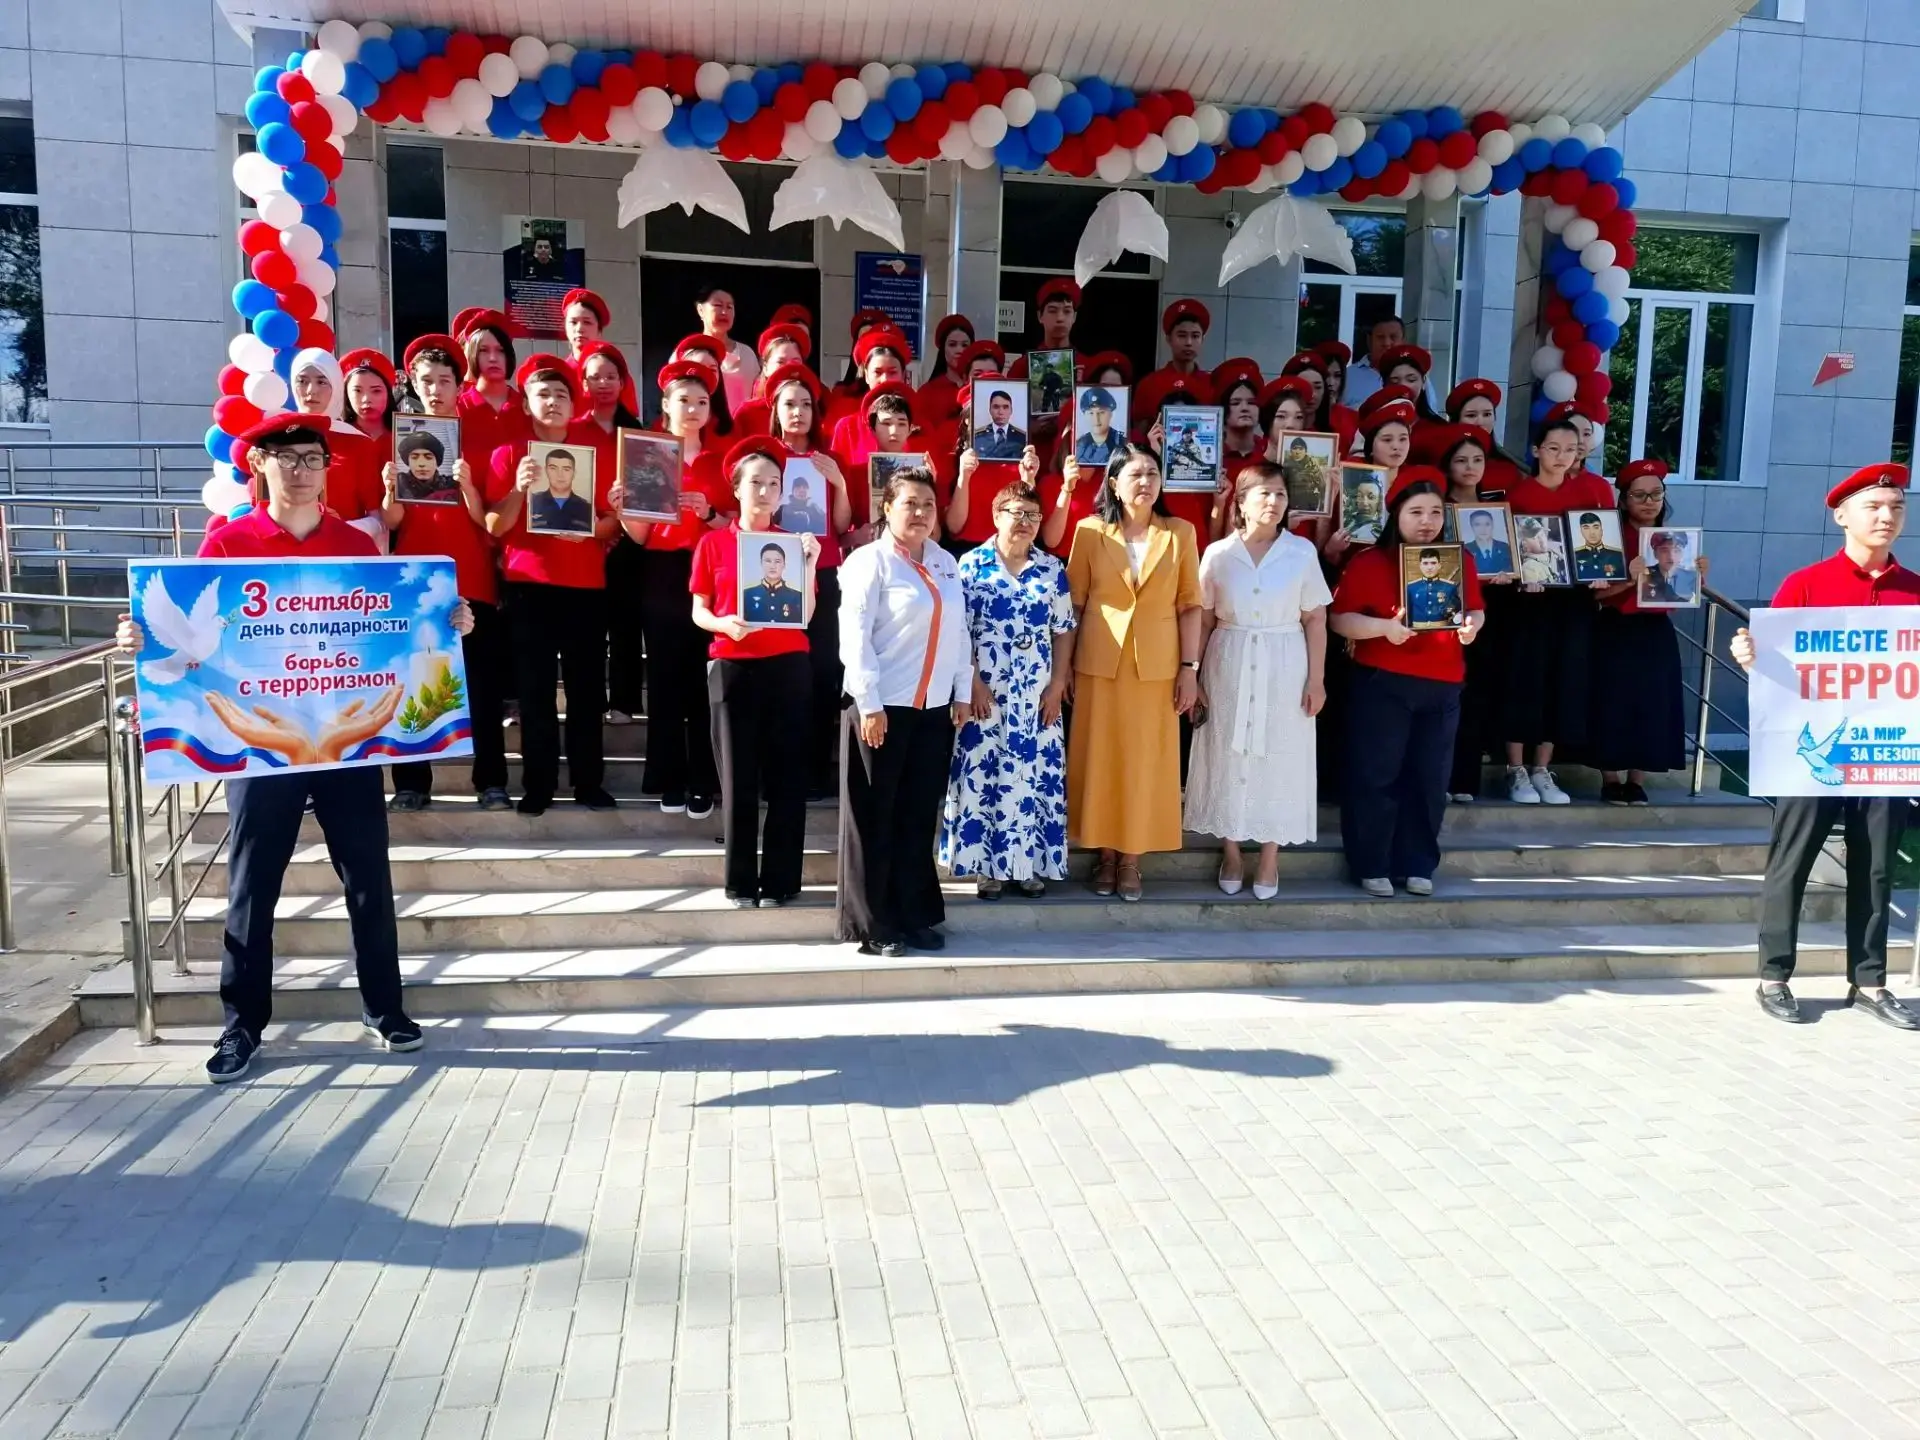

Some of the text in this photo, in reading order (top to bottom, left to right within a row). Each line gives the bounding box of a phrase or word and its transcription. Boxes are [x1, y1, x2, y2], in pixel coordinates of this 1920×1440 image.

[242, 582, 390, 617] 3 сентября
[240, 620, 408, 640] день солидарности
[319, 642, 327, 651] в
[1795, 630, 1888, 652] ВМЕСТЕ
[239, 673, 396, 697] с терроризмом
[1795, 662, 1920, 700] ТЕРРО
[1850, 727, 1907, 741] ЗА МИР
[1850, 747, 1920, 762] ЗА БЕЗОП
[1850, 767, 1920, 782] ЗА ЖИЗН
